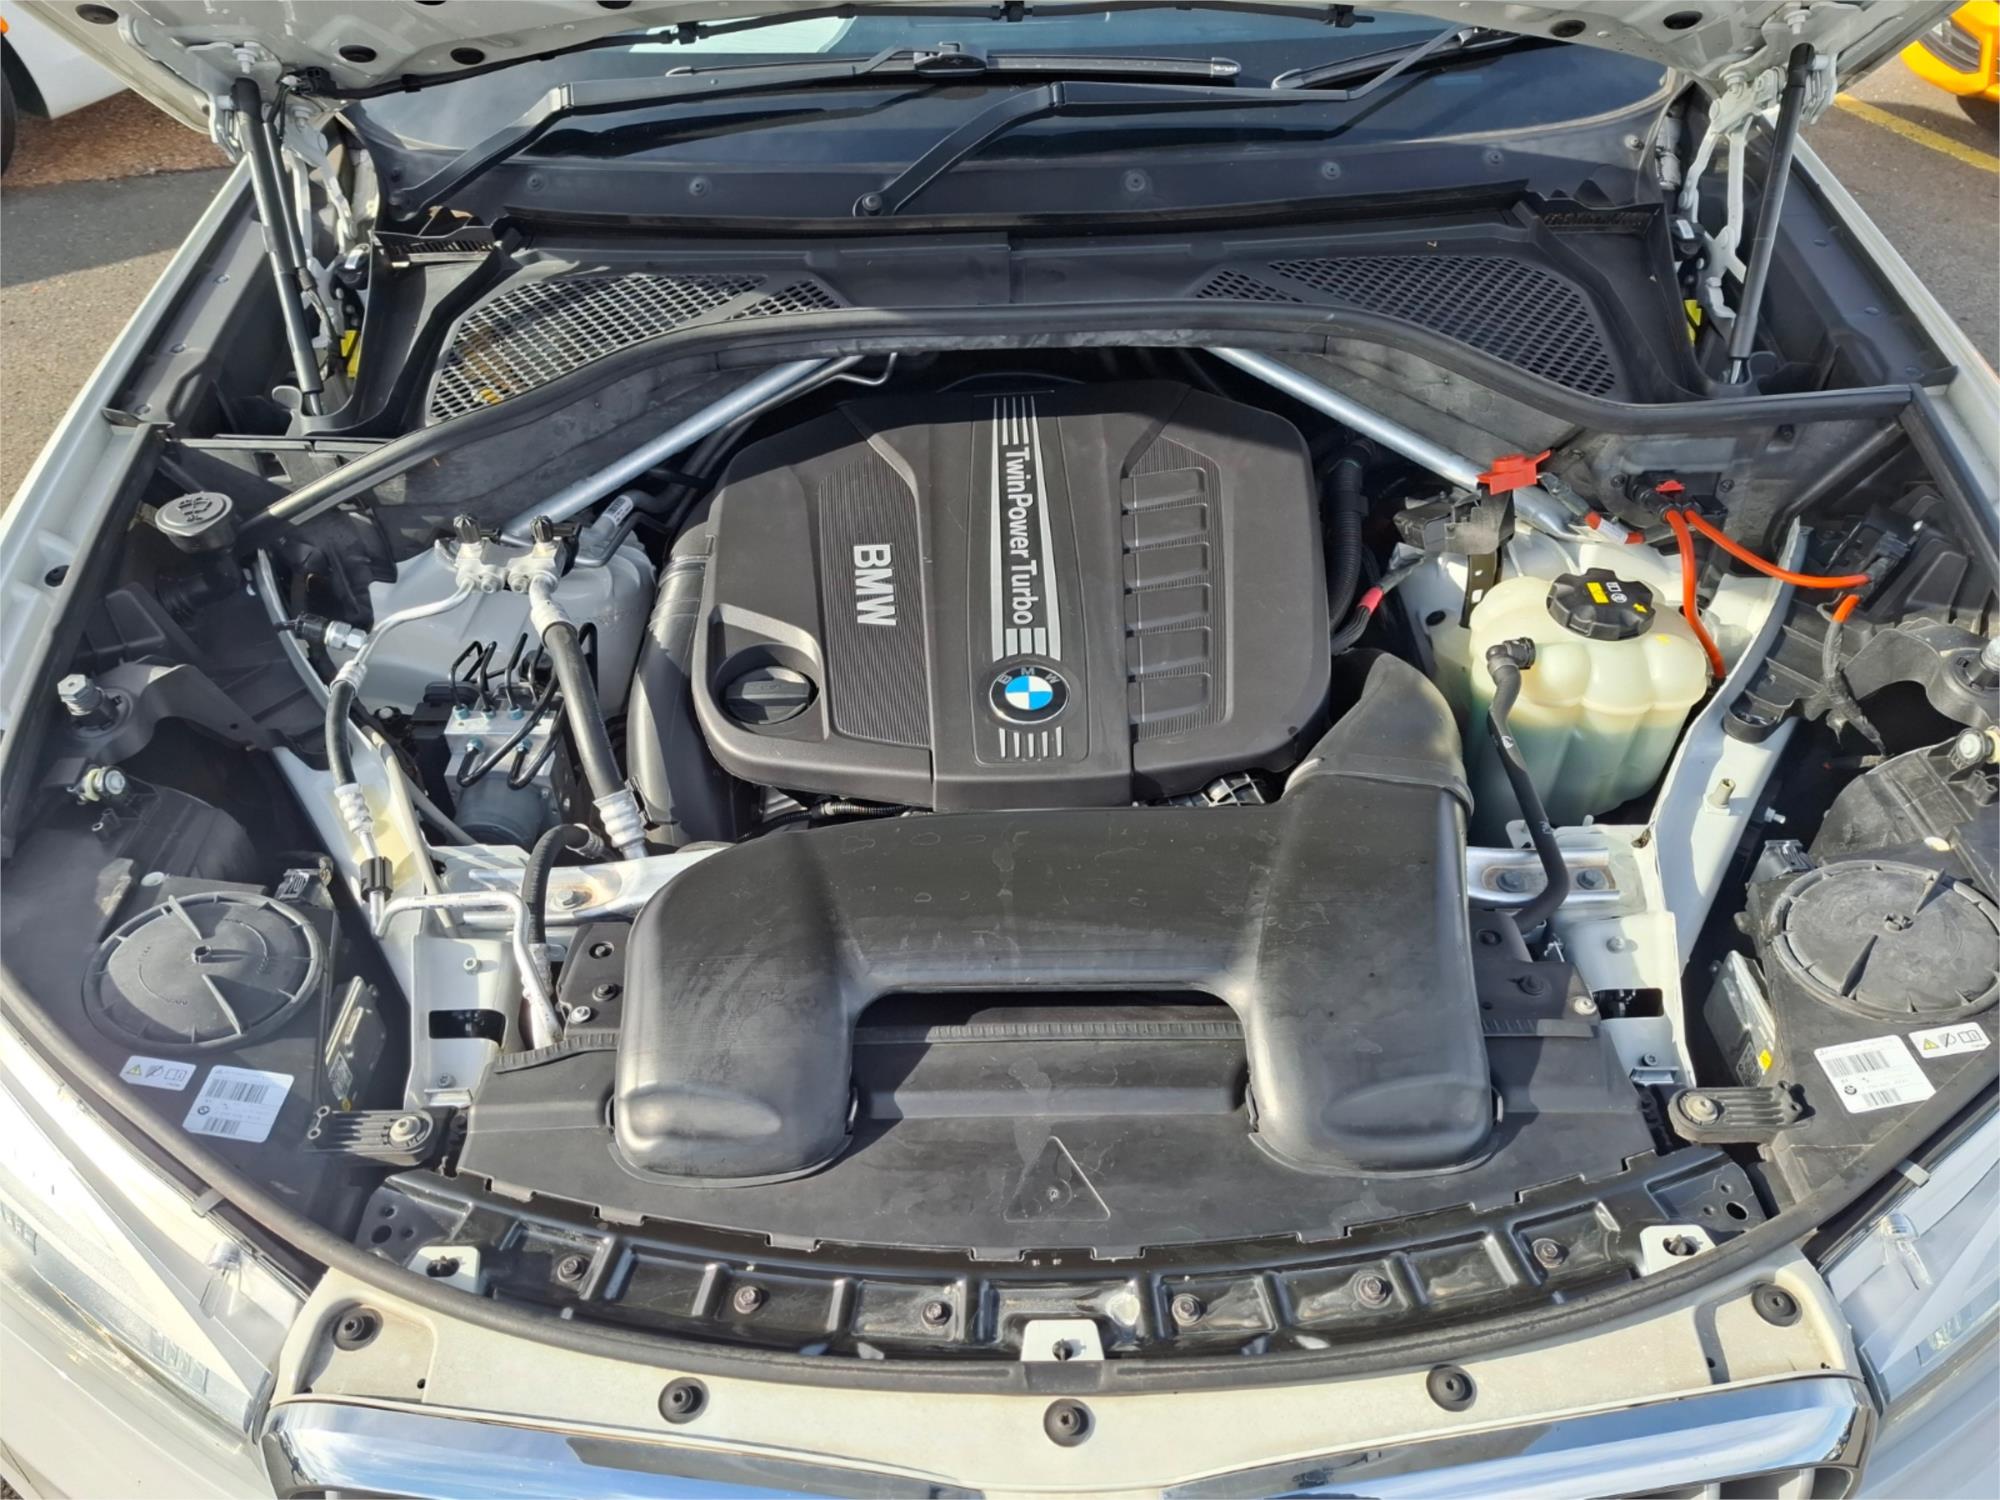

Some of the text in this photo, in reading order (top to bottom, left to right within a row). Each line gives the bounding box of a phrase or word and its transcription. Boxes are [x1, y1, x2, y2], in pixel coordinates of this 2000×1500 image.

[1005, 446, 1039, 625] TwinPower Turbo
[853, 544, 897, 626] BMW
[997, 666, 1060, 685] BMW
